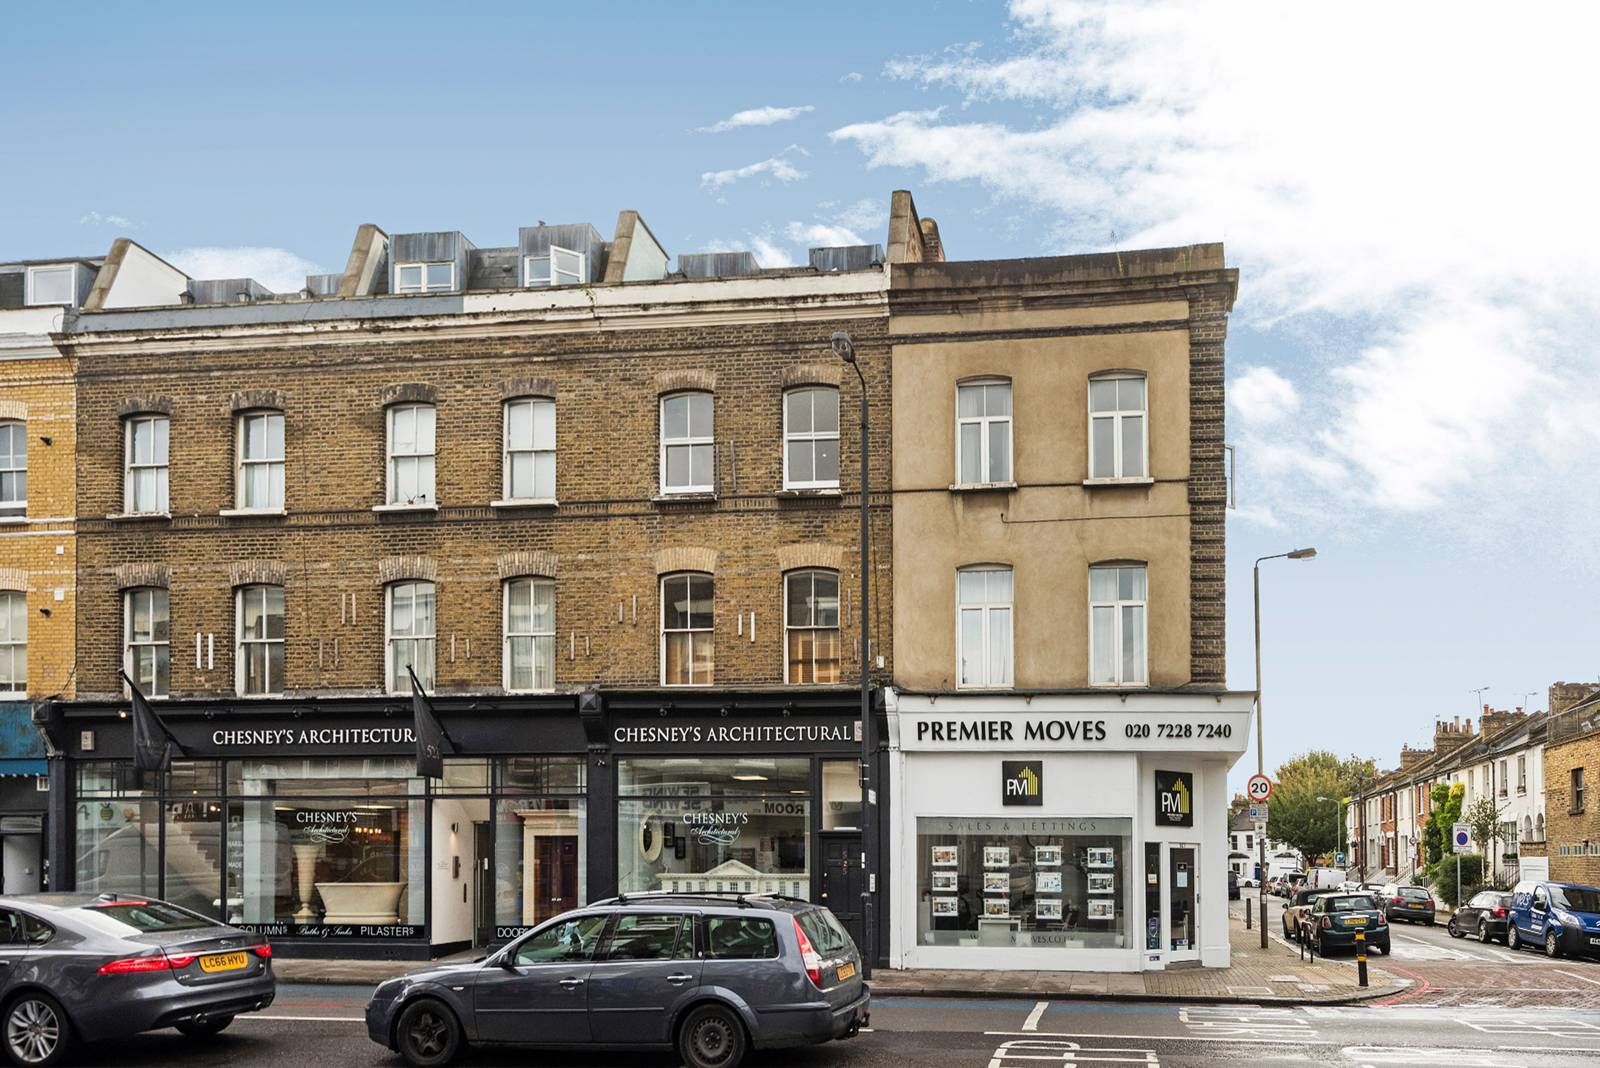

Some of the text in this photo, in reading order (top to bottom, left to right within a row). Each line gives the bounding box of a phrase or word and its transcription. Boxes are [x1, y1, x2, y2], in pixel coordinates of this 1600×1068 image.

[212, 727, 417, 745] CHESNEY'S ARCHITECTUR
[612, 726, 701, 743] CHESNEY'S
[706, 725, 852, 742] ARCHITECTURAL
[917, 720, 1233, 741] PREMIER MOVES 020 7228 7240
[1006, 778, 1028, 796] PM
[1251, 782, 1268, 793] 20
[1161, 791, 1181, 813] PM
[296, 811, 358, 824] CHESNEY'S
[683, 812, 749, 825] CHESNEY'S
[948, 821, 1097, 832] SALES & LETTINGS
[203, 953, 245, 969] LC66 HYU
